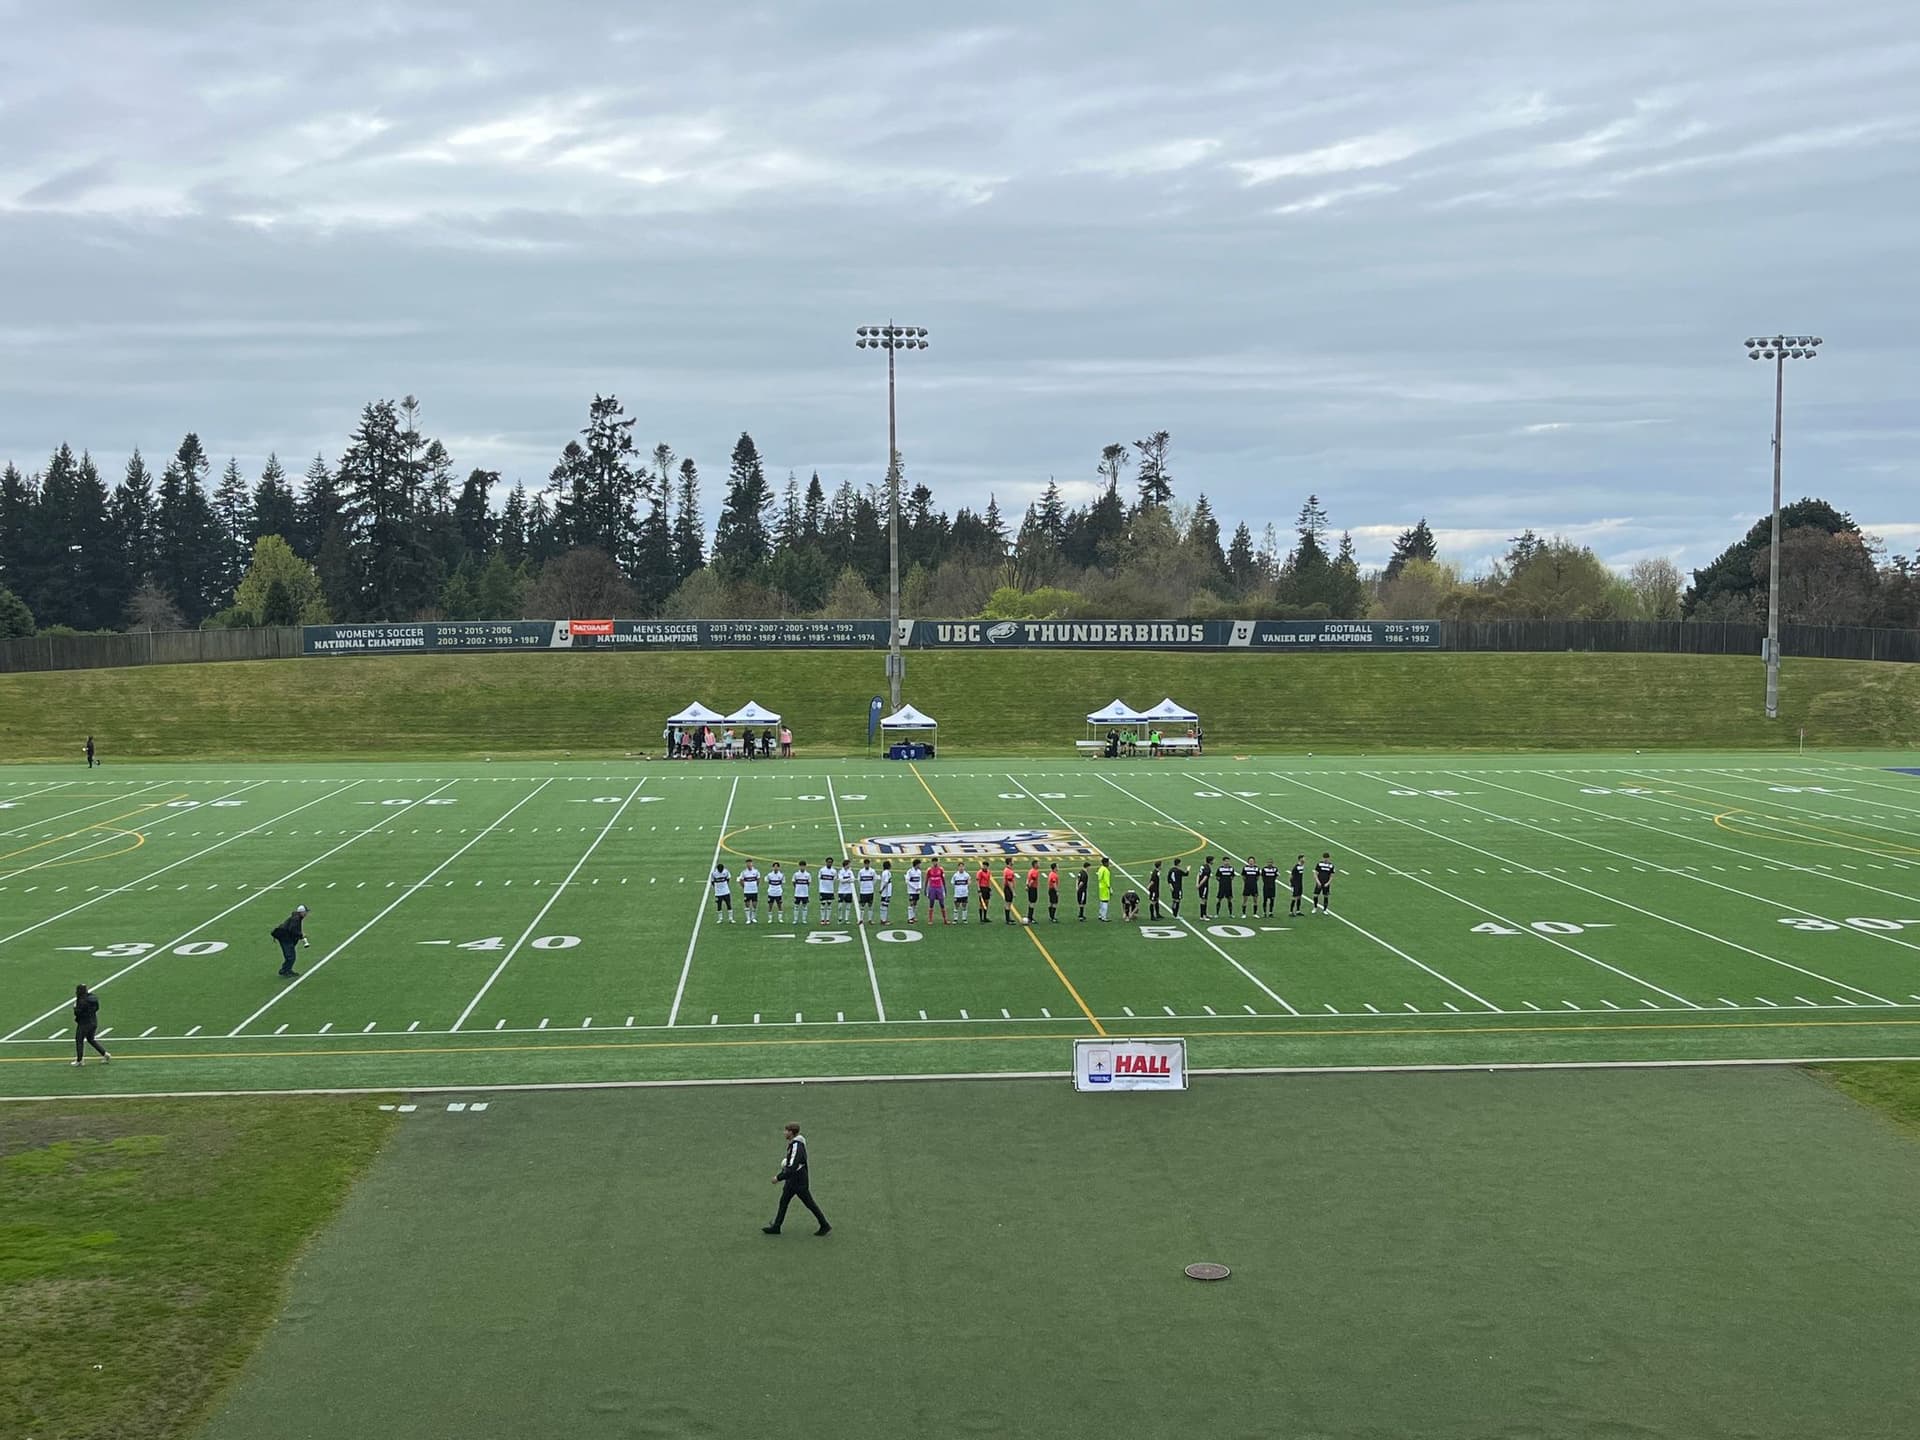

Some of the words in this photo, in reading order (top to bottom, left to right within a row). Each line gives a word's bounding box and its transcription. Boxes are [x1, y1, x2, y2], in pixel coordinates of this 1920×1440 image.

[437, 627, 456, 635] 2019
[464, 627, 484, 635] 2015
[491, 626, 512, 634] 2006
[633, 625, 661, 633] MEN'S
[664, 625, 698, 633] SOCCER
[710, 624, 727, 632] 2013
[735, 624, 752, 632] 2012
[759, 624, 777, 632] 2007
[785, 624, 804, 632] 2005
[811, 624, 829, 632] 1994
[836, 624, 853, 632] 1992
[1324, 625, 1373, 633] FOOTBALL
[1384, 625, 1404, 633] 2015
[1411, 625, 1430, 633] 1997
[335, 628, 384, 639] WOMEN'S
[387, 628, 424, 637] SOCCER
[937, 624, 981, 642] UBC
[1024, 624, 1205, 642] THUNDERBIRDS
[437, 637, 458, 645] 2003
[466, 637, 486, 645] 2002
[494, 637, 513, 645] 1993
[521, 636, 539, 644] 1987
[597, 634, 644, 642] NATIONAL
[646, 634, 698, 642] CHAMPIONS
[710, 634, 727, 642] 1991
[733, 634, 751, 642] 1990
[858, 634, 875, 642] 1974
[1262, 634, 1296, 643] VANIER
[1298, 634, 1316, 642] CUP
[1318, 634, 1373, 642] CHAMPIONS
[1384, 635, 1404, 643] 1986
[1411, 635, 1430, 643] 1982
[314, 639, 365, 649] NATIONAL
[367, 638, 425, 648] CHAMPIONS
[854, 841, 1101, 858] UBC
[1115, 1055, 1171, 1073] HALL
